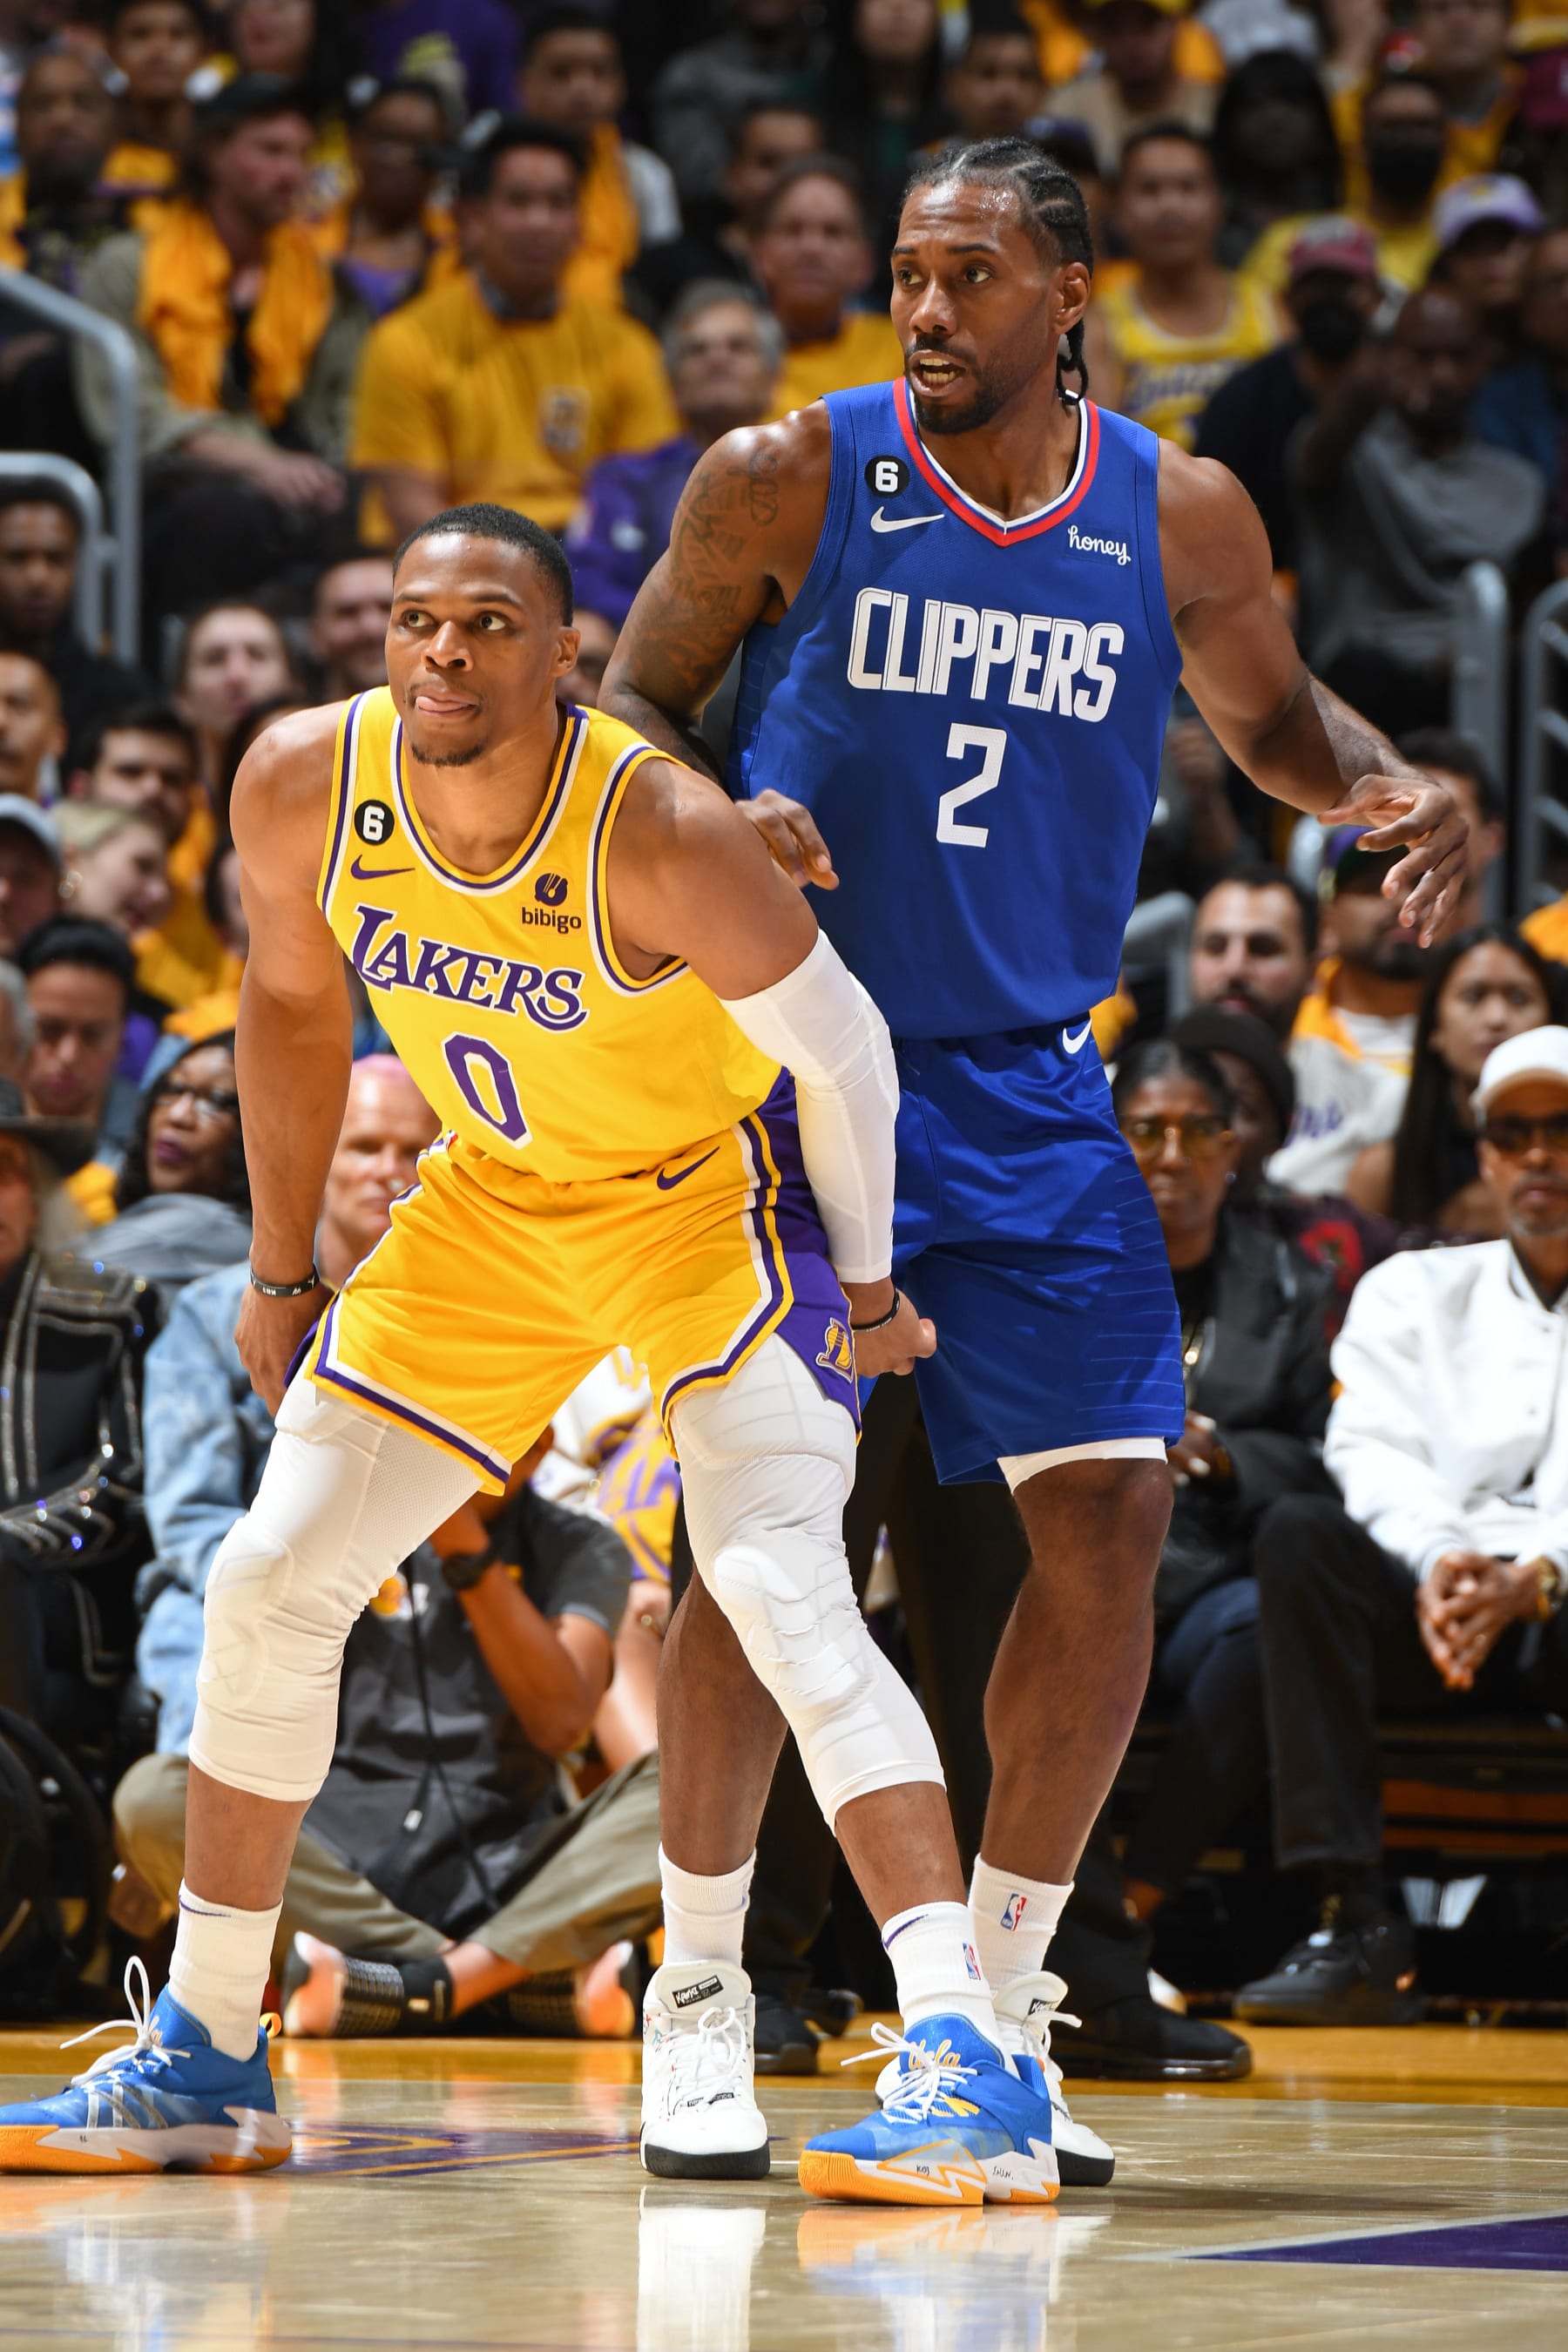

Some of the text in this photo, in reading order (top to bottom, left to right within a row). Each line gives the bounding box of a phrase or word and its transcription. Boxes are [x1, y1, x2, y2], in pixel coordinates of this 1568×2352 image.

[875, 461, 898, 492] 6
[1068, 525, 1131, 565] honey
[847, 587, 1125, 722] CLIPPERS
[362, 806, 385, 841] 6
[936, 723, 1007, 848] 2
[522, 907, 582, 934] bibigo
[349, 903, 591, 1033] LAKERS
[442, 1031, 532, 1150] 0
